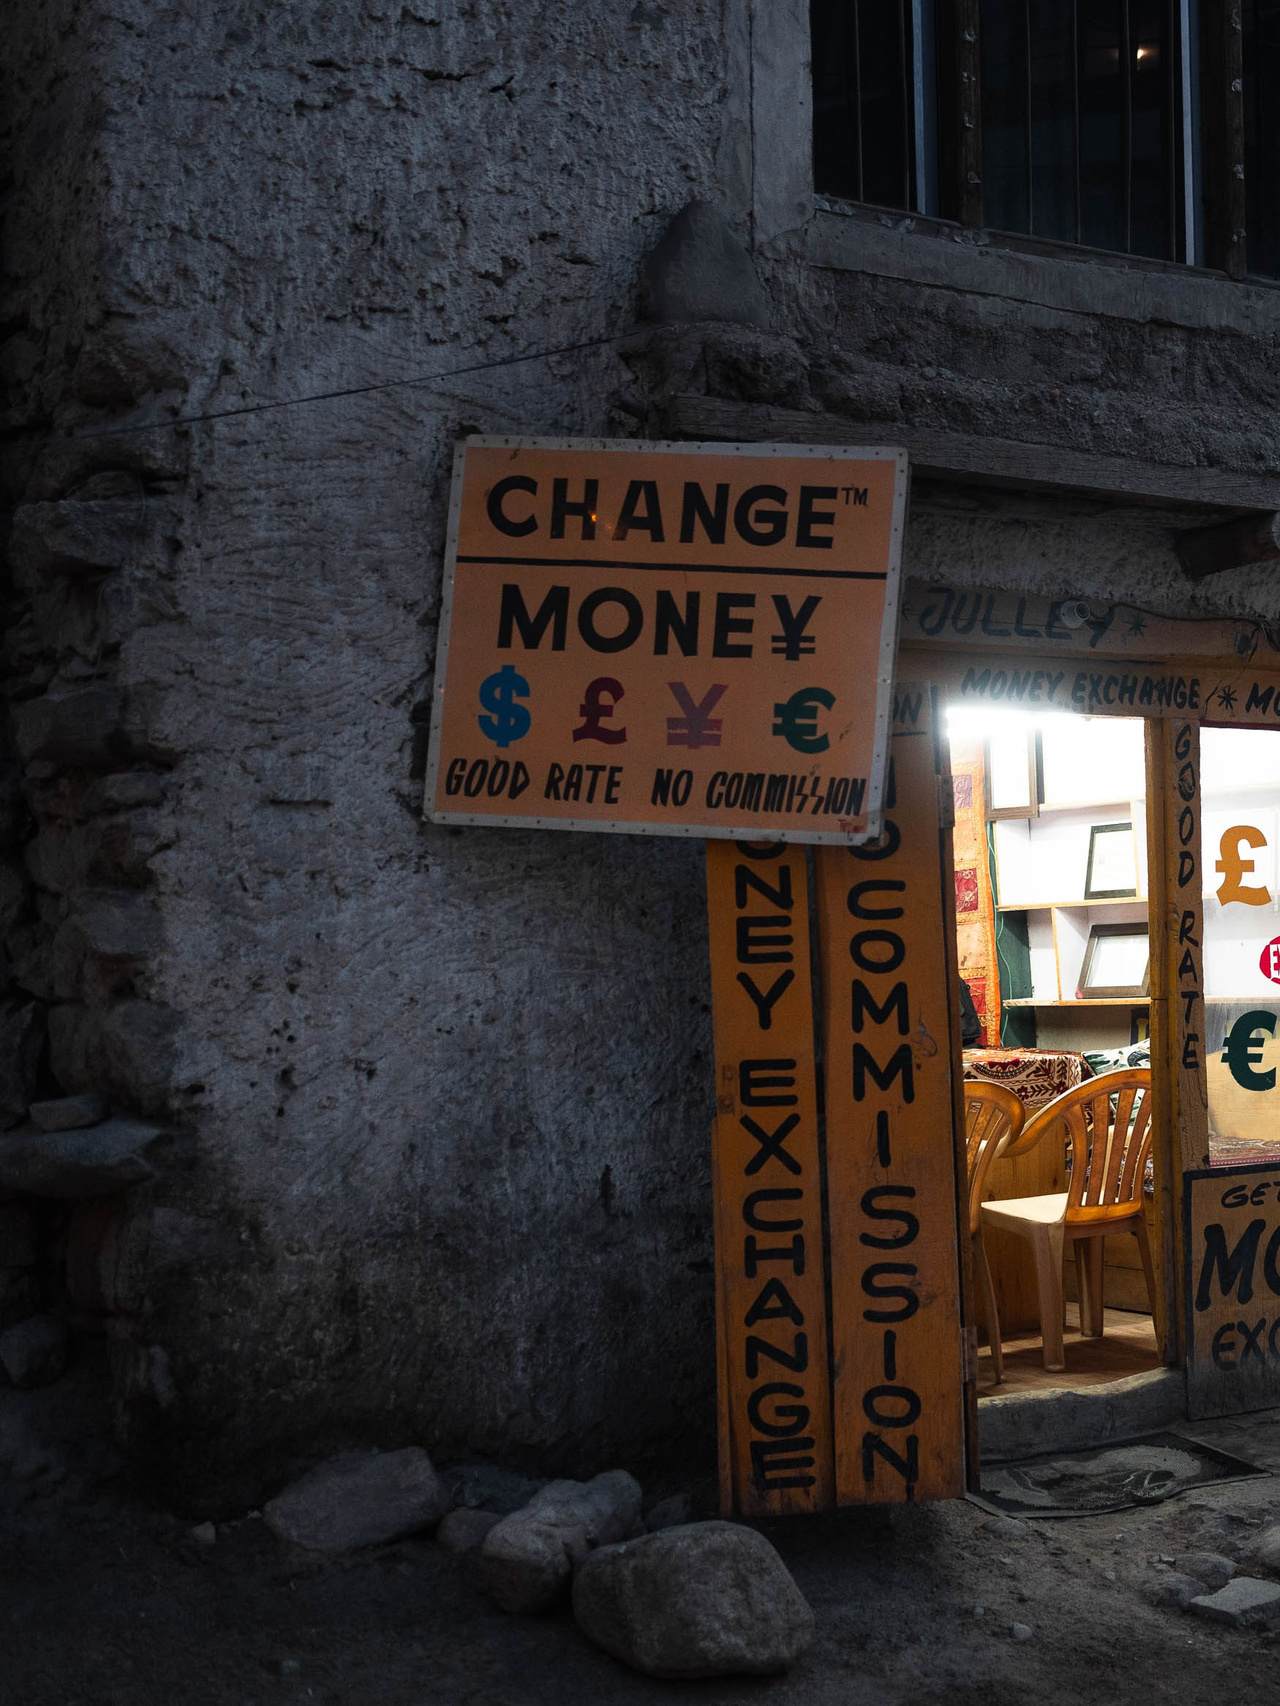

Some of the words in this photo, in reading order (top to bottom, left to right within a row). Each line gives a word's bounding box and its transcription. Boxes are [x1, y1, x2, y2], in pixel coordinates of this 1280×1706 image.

[477, 665, 532, 748] $
[772, 686, 837, 754] €
[961, 666, 1065, 703] MONEY
[1071, 671, 1200, 710] EXCHANGE
[445, 758, 531, 800] GOOD
[545, 763, 624, 804] RATE
[651, 768, 694, 807] NO
[706, 771, 868, 816] COMMISSION
[1174, 724, 1198, 888] GOOD
[1215, 825, 1273, 907] £
[1178, 910, 1200, 1070] RATE
[1220, 1010, 1277, 1093] €
[847, 879, 921, 1484] COMMISSION
[738, 1057, 817, 1491] EXCHANGE
